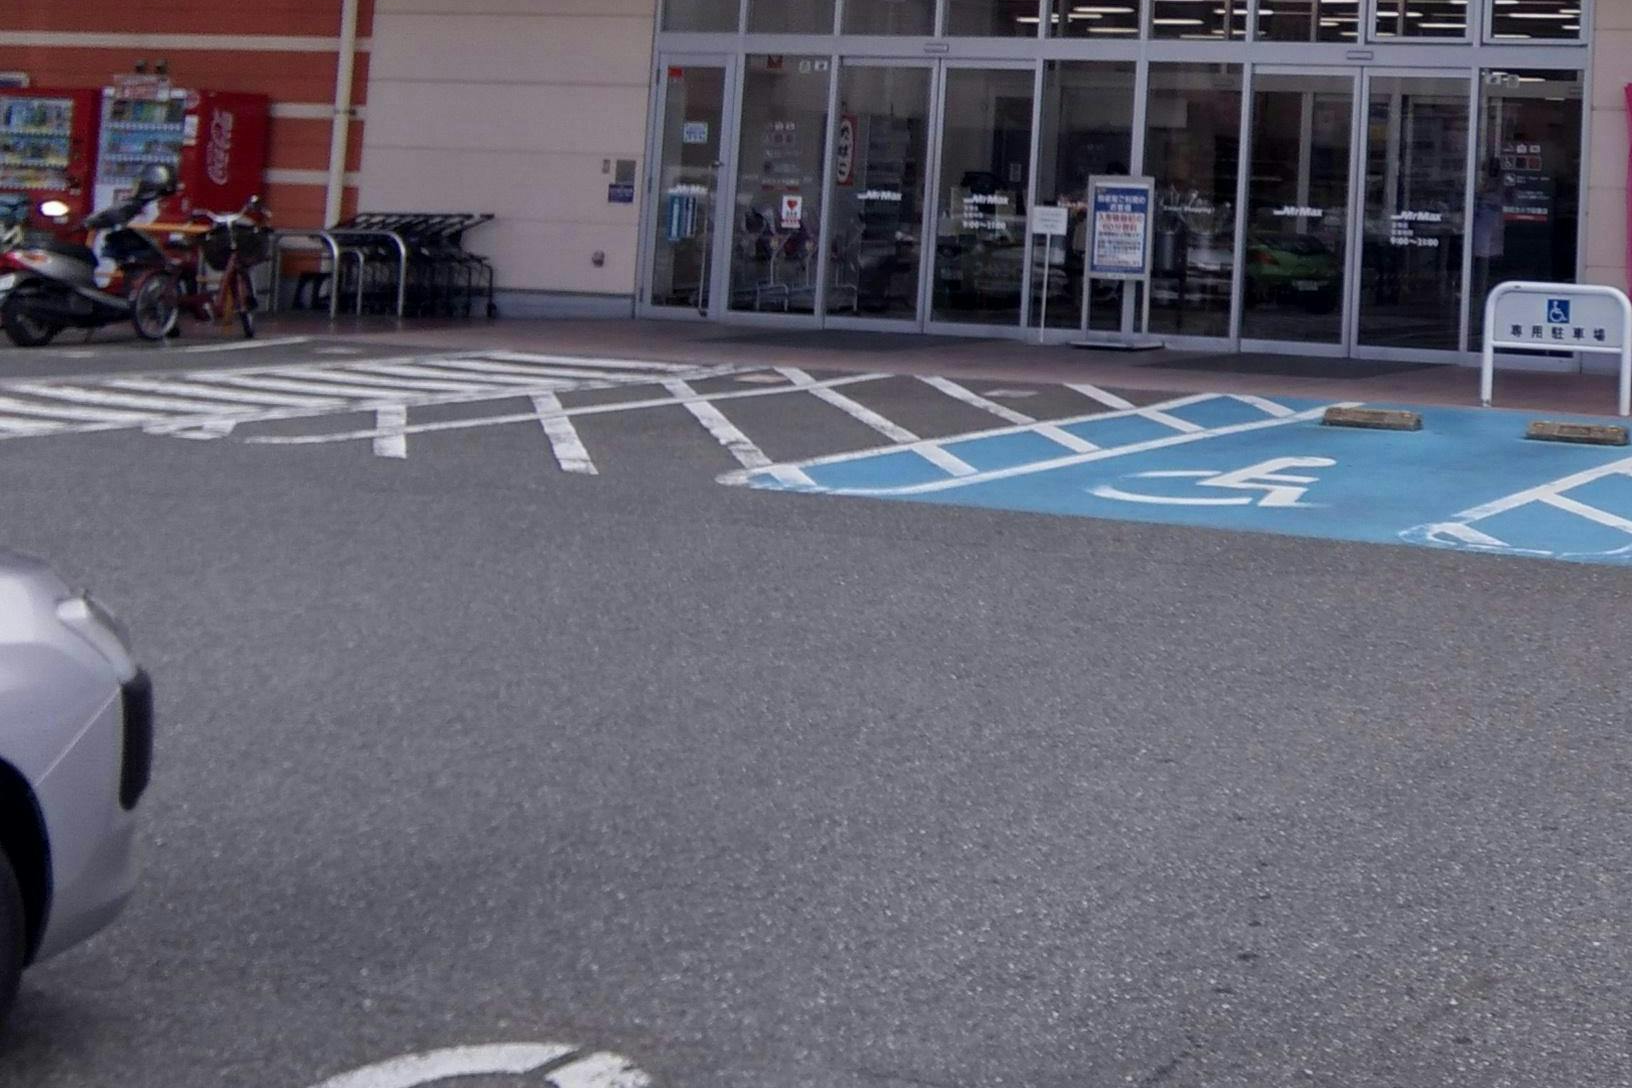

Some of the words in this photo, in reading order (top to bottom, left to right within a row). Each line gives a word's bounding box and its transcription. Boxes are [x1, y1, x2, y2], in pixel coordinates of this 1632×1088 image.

[1273, 205, 1323, 217] MrMax
[1390, 210, 1442, 222] MrMax
[1509, 323, 1606, 343] 専用駐車場
